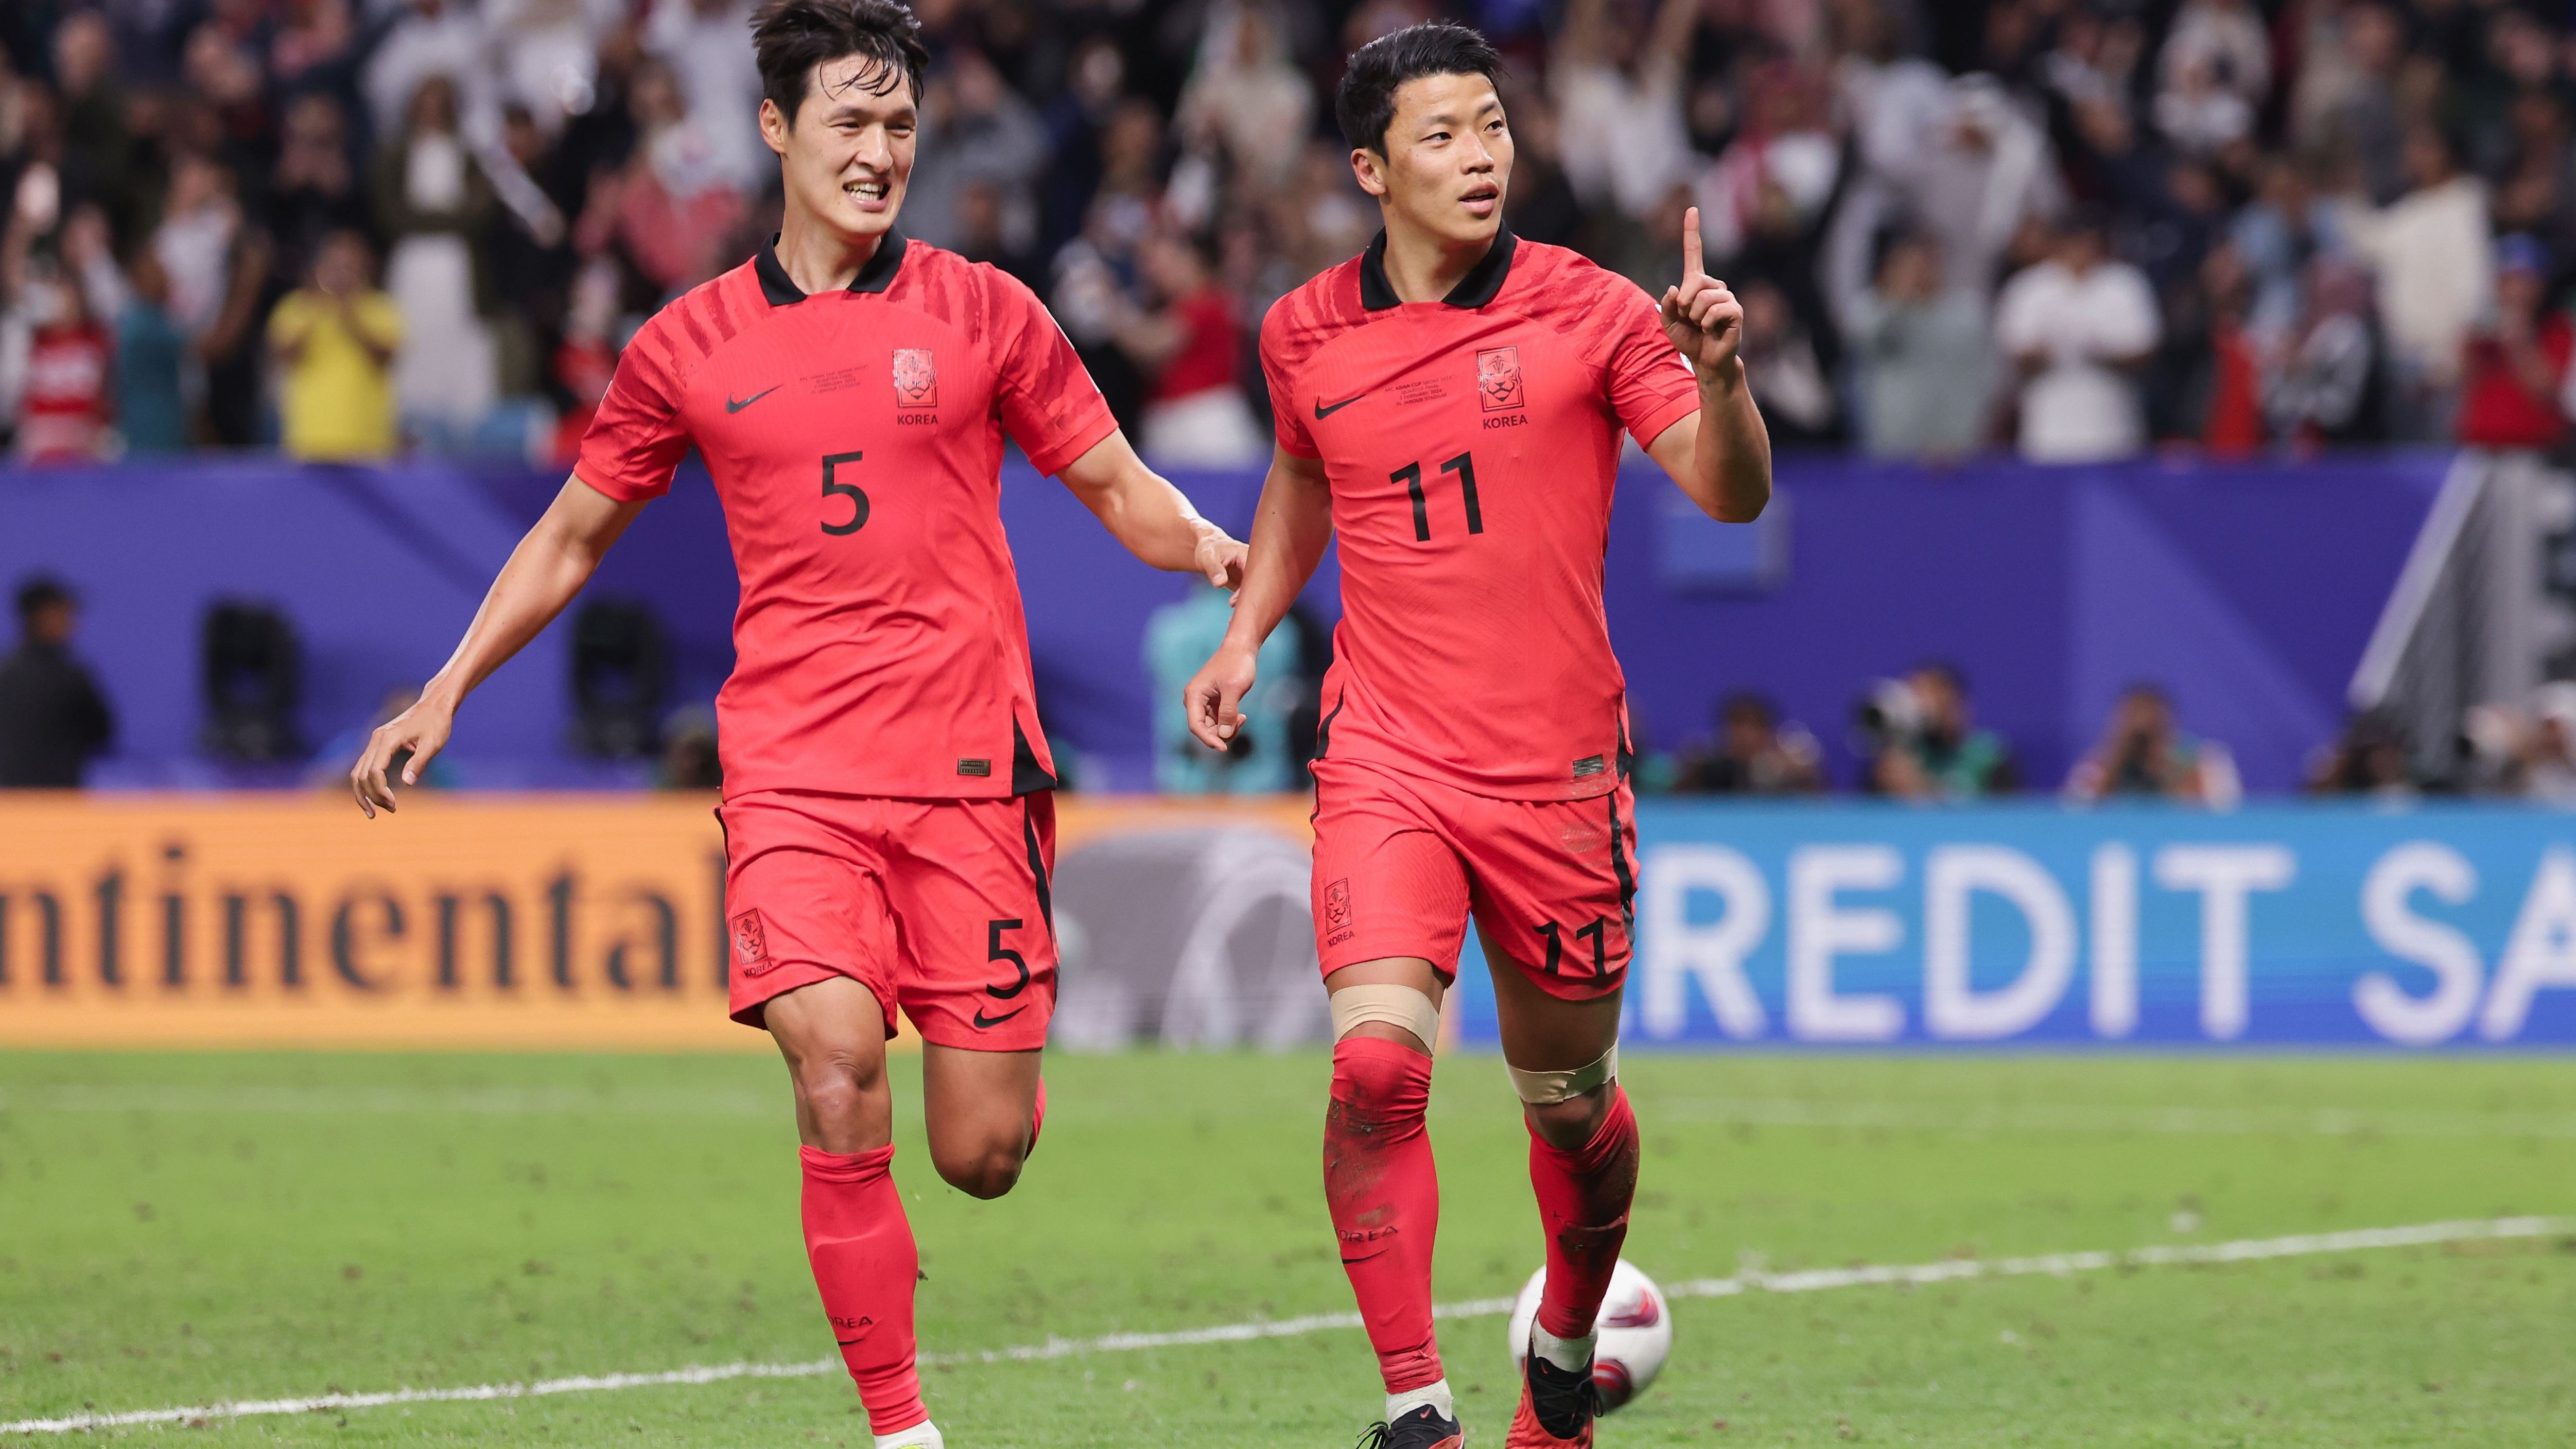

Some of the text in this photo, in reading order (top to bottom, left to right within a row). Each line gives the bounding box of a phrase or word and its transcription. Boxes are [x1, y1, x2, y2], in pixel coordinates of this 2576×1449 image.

[897, 414, 938, 425] KOREA
[1483, 414, 1528, 430] KOREA
[821, 451, 870, 536] 5
[1389, 450, 1484, 542] 11
[744, 961, 772, 979] KOREA
[986, 919, 1031, 1000] 5
[1328, 931, 1355, 948] KOREA
[1532, 915, 1606, 976] 11
[1619, 842, 2296, 1041] REDIT
